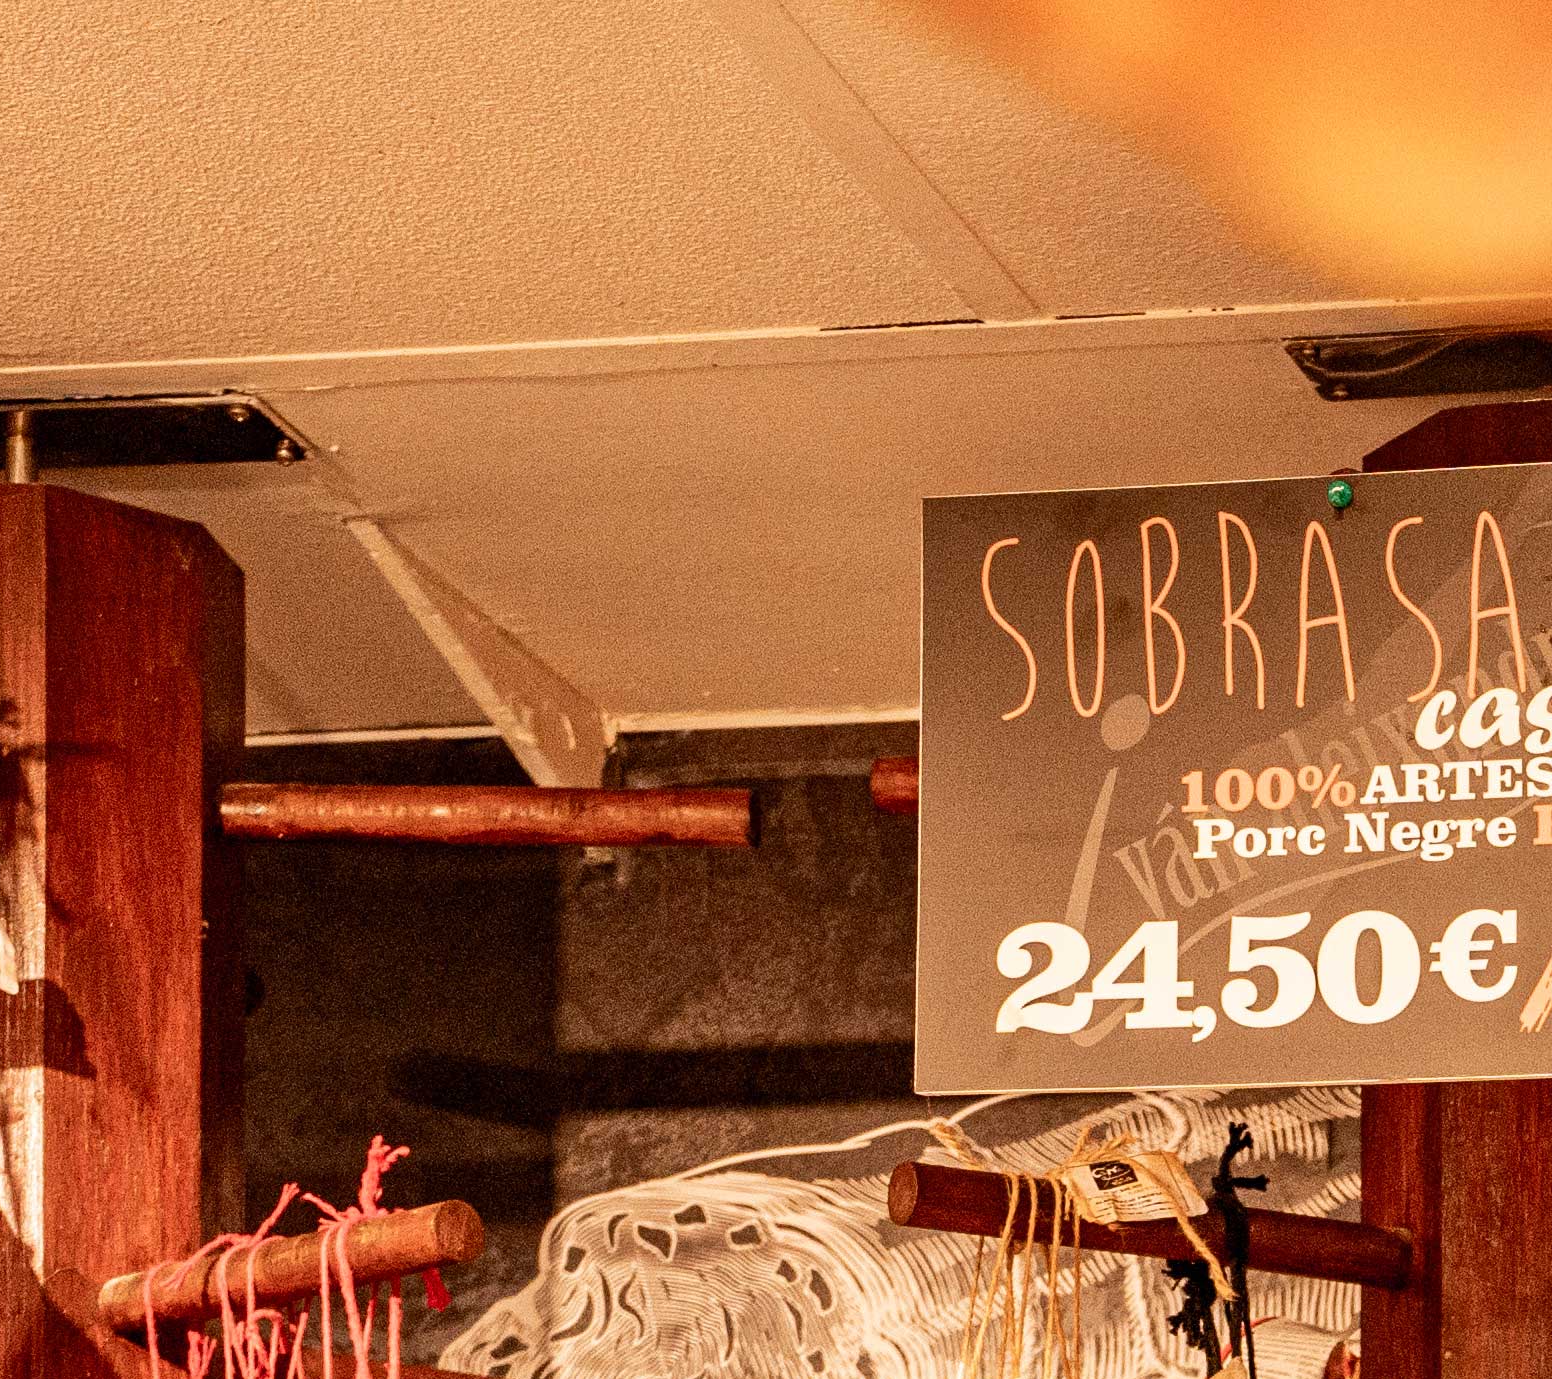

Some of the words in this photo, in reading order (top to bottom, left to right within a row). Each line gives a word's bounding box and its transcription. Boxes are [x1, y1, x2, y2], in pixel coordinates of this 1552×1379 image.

[1181, 763, 1356, 813] 100%
[1193, 818, 1326, 859] Porc
[1344, 811, 1518, 862] Negre
